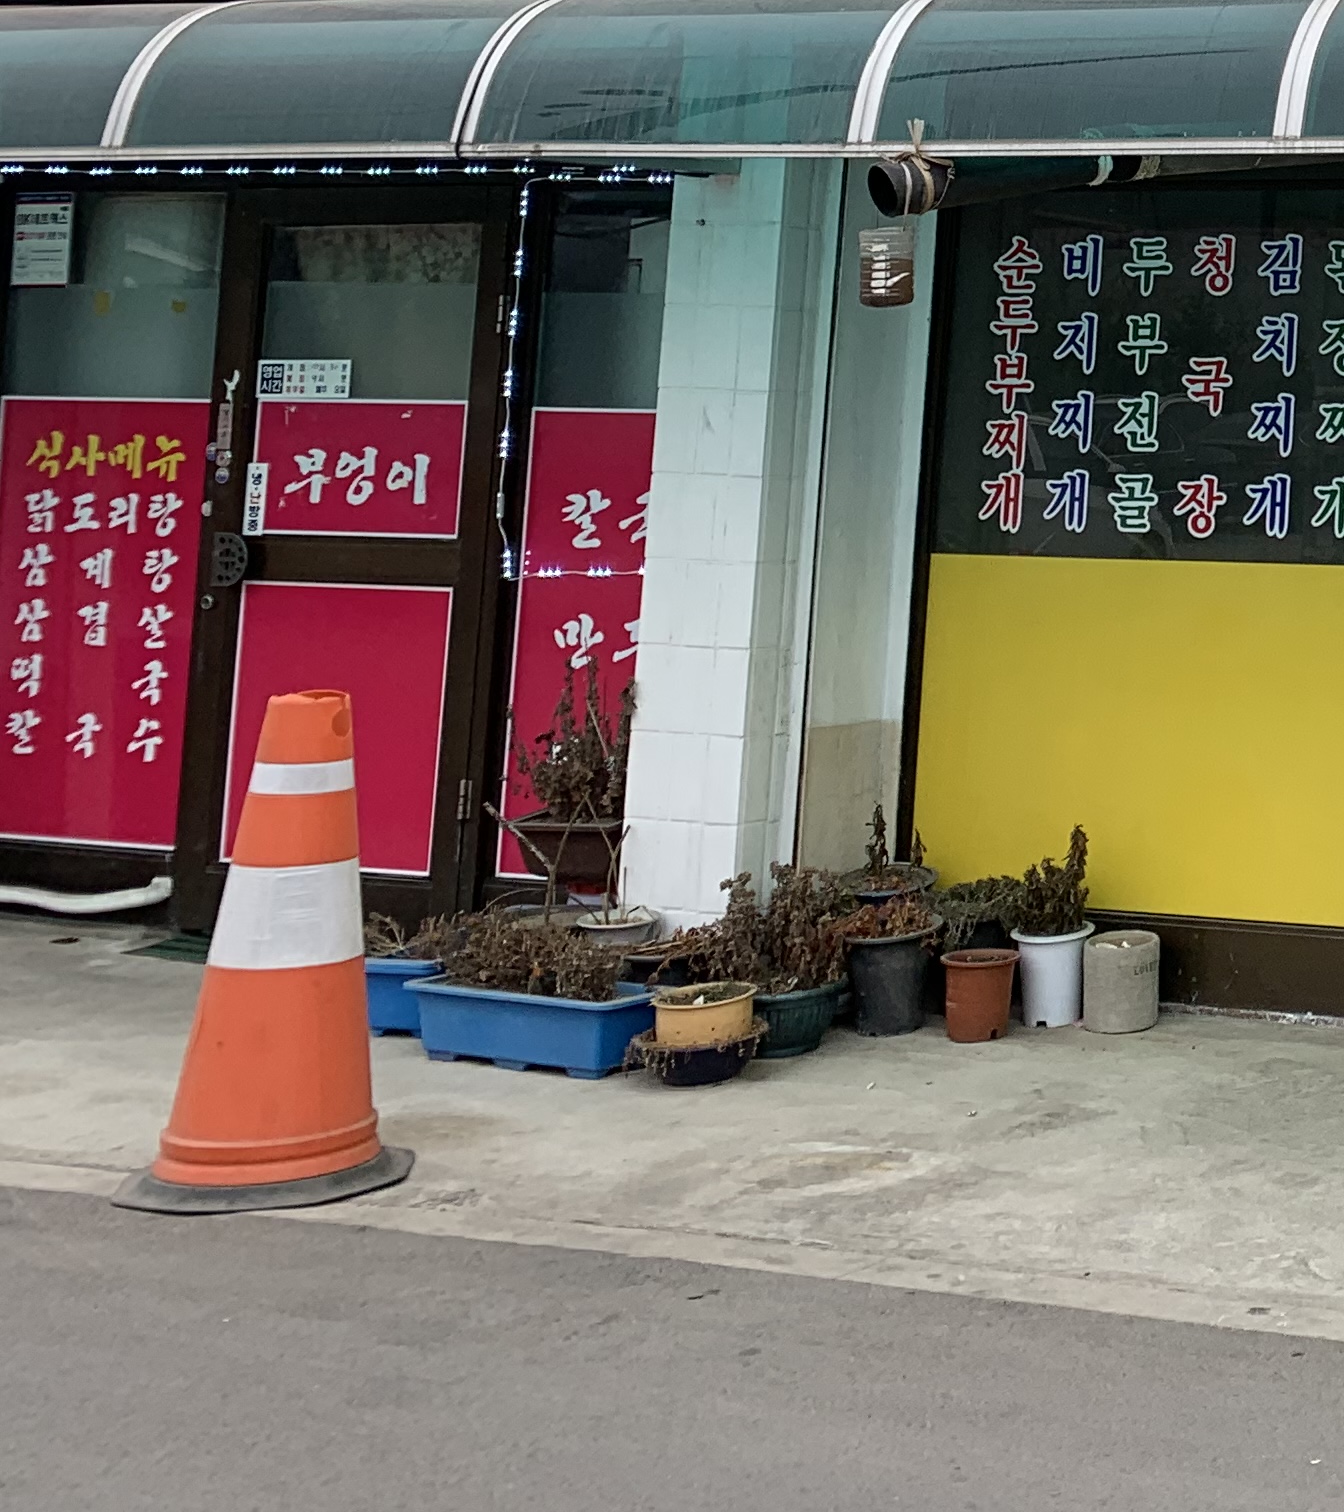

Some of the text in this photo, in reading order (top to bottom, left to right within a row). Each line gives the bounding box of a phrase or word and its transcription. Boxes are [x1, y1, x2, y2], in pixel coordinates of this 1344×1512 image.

[26, 430, 187, 482] 식사메뉴
[979, 236, 1042, 534] 순두부찌개
[1044, 234, 1103, 533] 비지찌개
[1108, 236, 1172, 533] 두부전골
[1173, 235, 1236, 539] 청국장
[1243, 234, 1303, 539] 김치찌개
[18, 543, 179, 593] 삼계탕
[24, 488, 184, 537] 닭도리탕
[14, 598, 173, 649] 삼겹살
[5, 709, 164, 763] 칼국수
